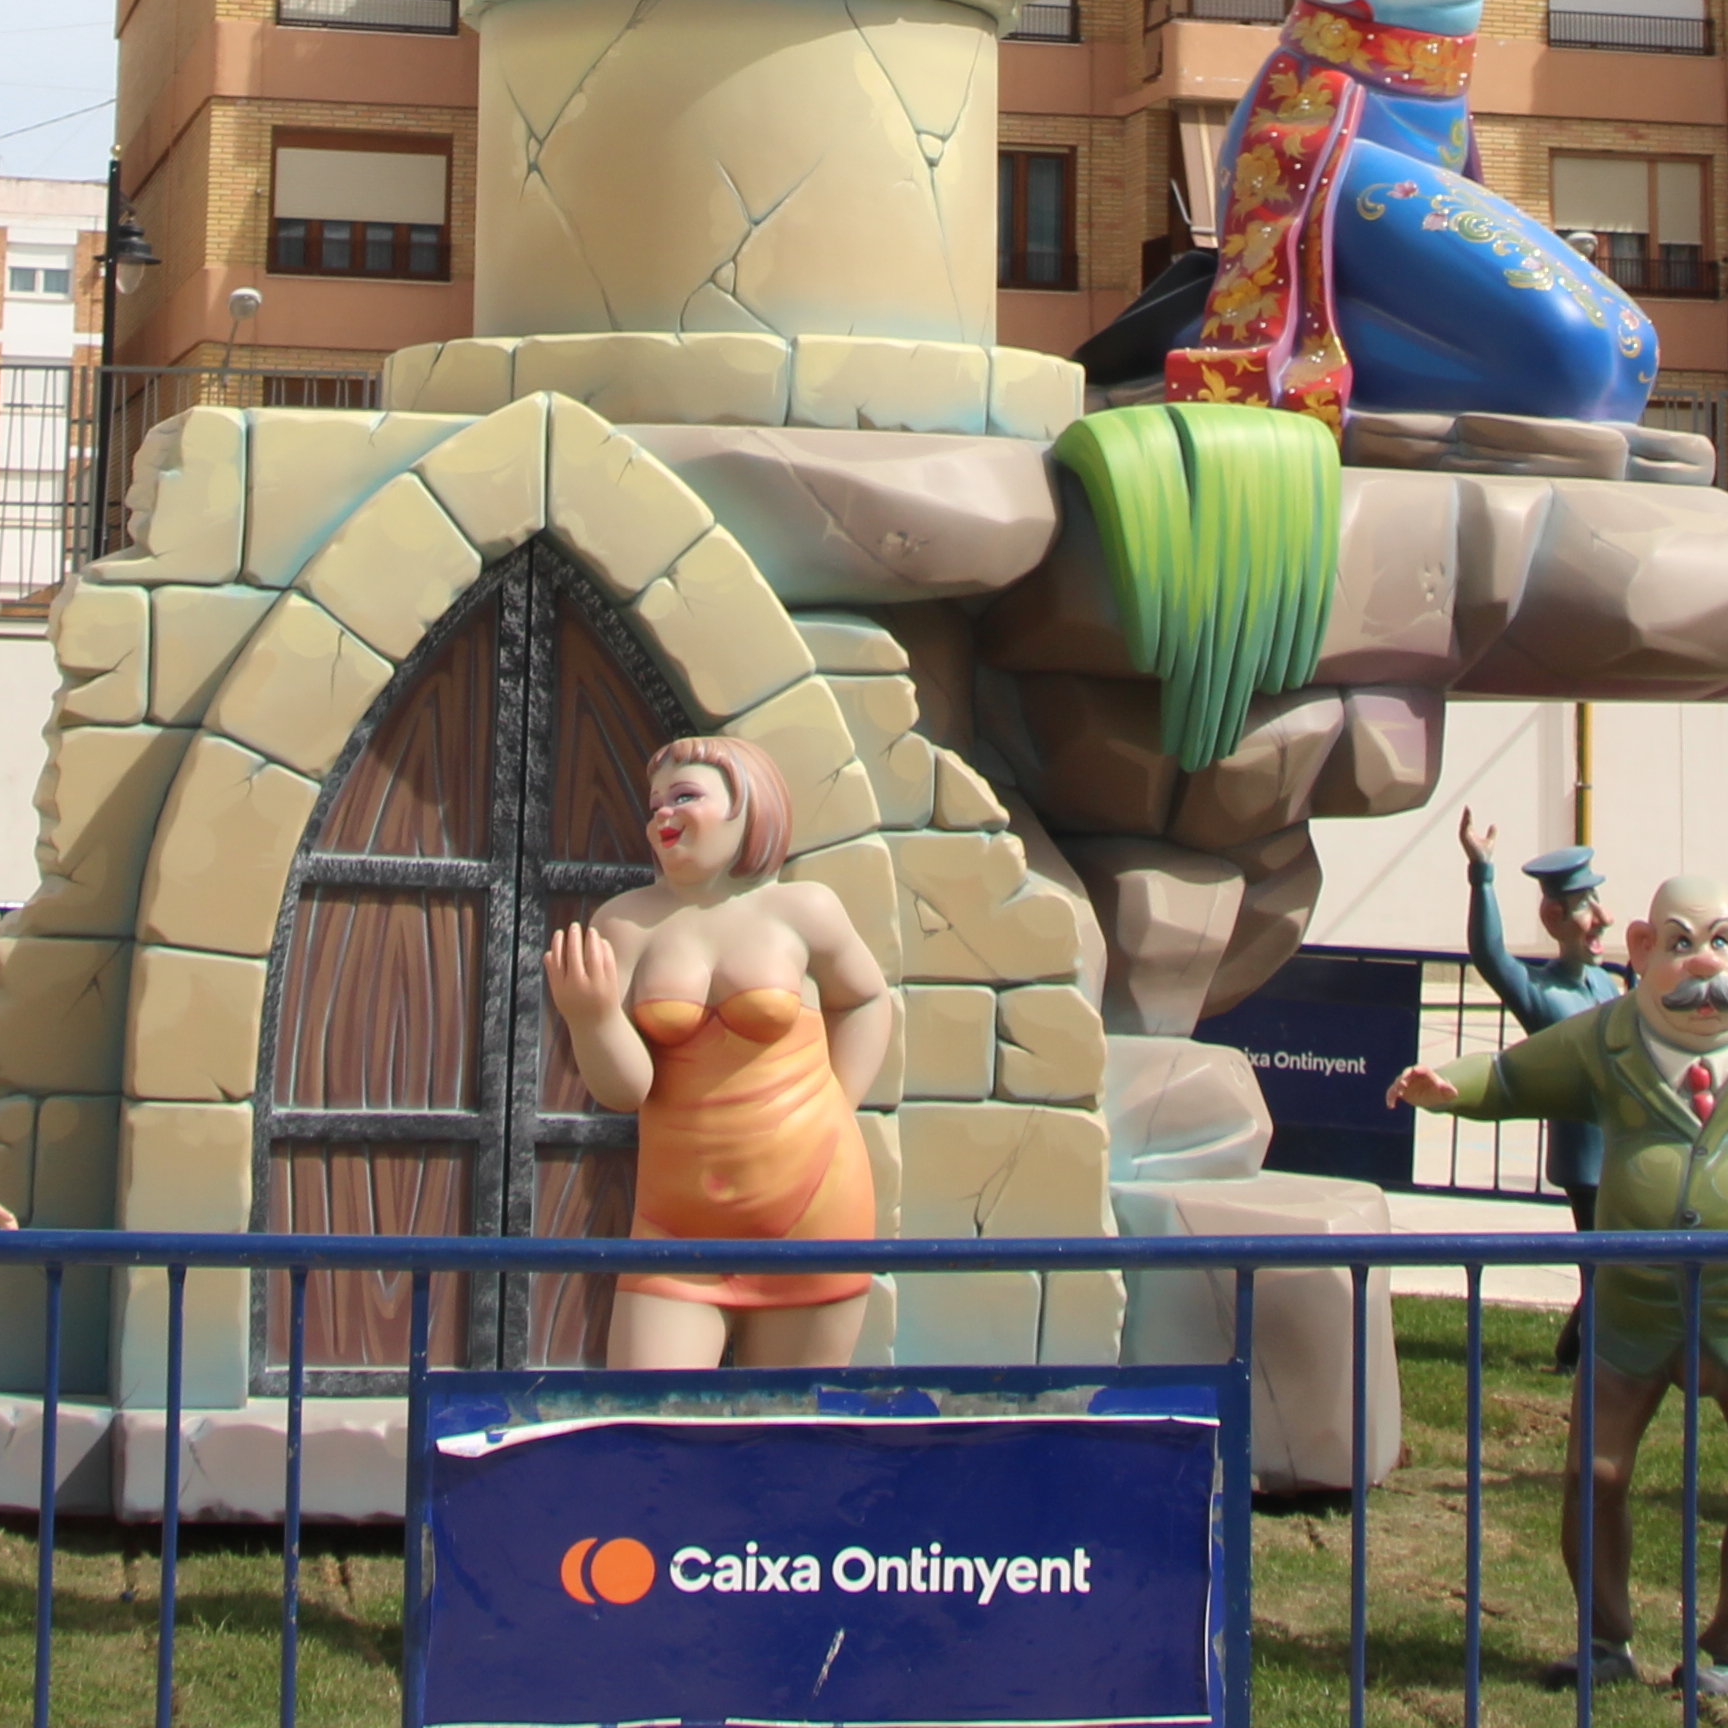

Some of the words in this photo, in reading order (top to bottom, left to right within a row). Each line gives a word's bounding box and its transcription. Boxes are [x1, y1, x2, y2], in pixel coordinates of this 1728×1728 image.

[1274, 1051, 1367, 1076] Ontinyent
[670, 1541, 821, 1594] Caixa
[832, 1541, 1091, 1605] Ontinyent
